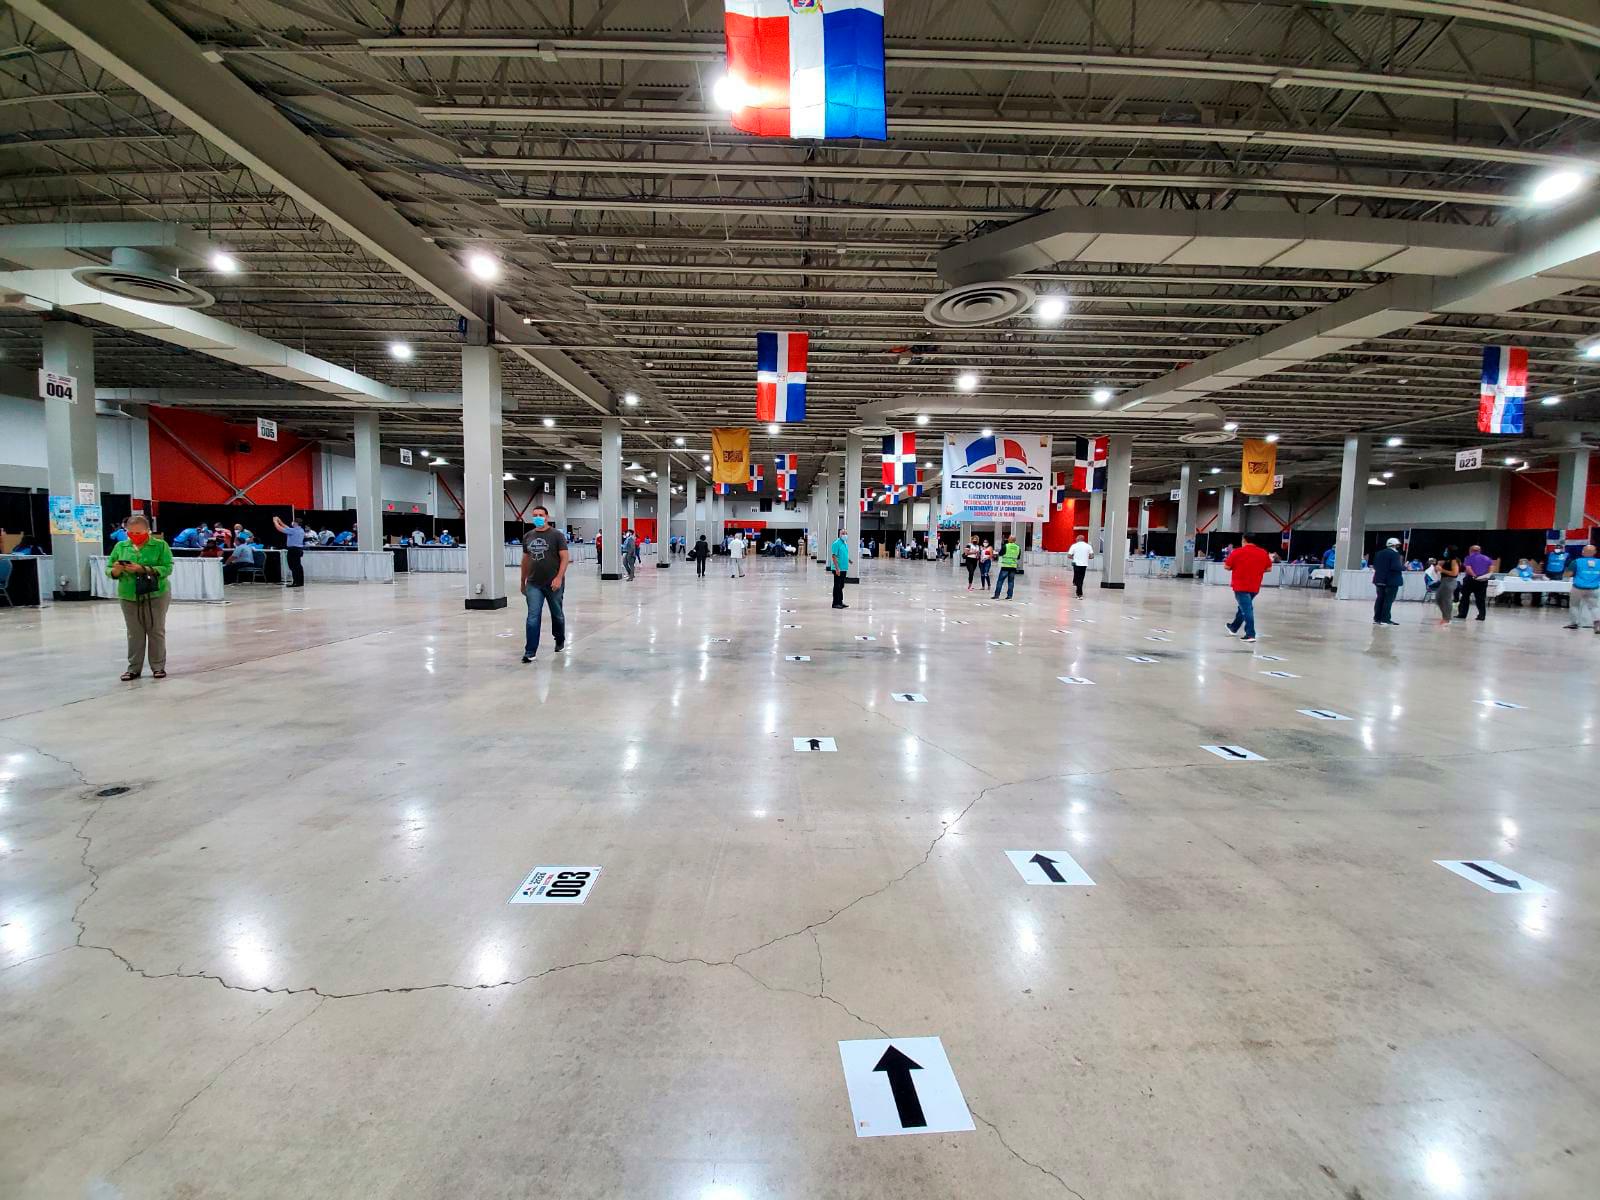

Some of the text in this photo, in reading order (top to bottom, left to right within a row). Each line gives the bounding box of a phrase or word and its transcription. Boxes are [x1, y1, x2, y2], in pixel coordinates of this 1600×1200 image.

[46, 382, 72, 400] 004
[261, 426, 274, 438] 005
[1459, 458, 1477, 468] 023
[950, 480, 1042, 490] ELECCIONES 2020
[546, 872, 590, 898] 003
